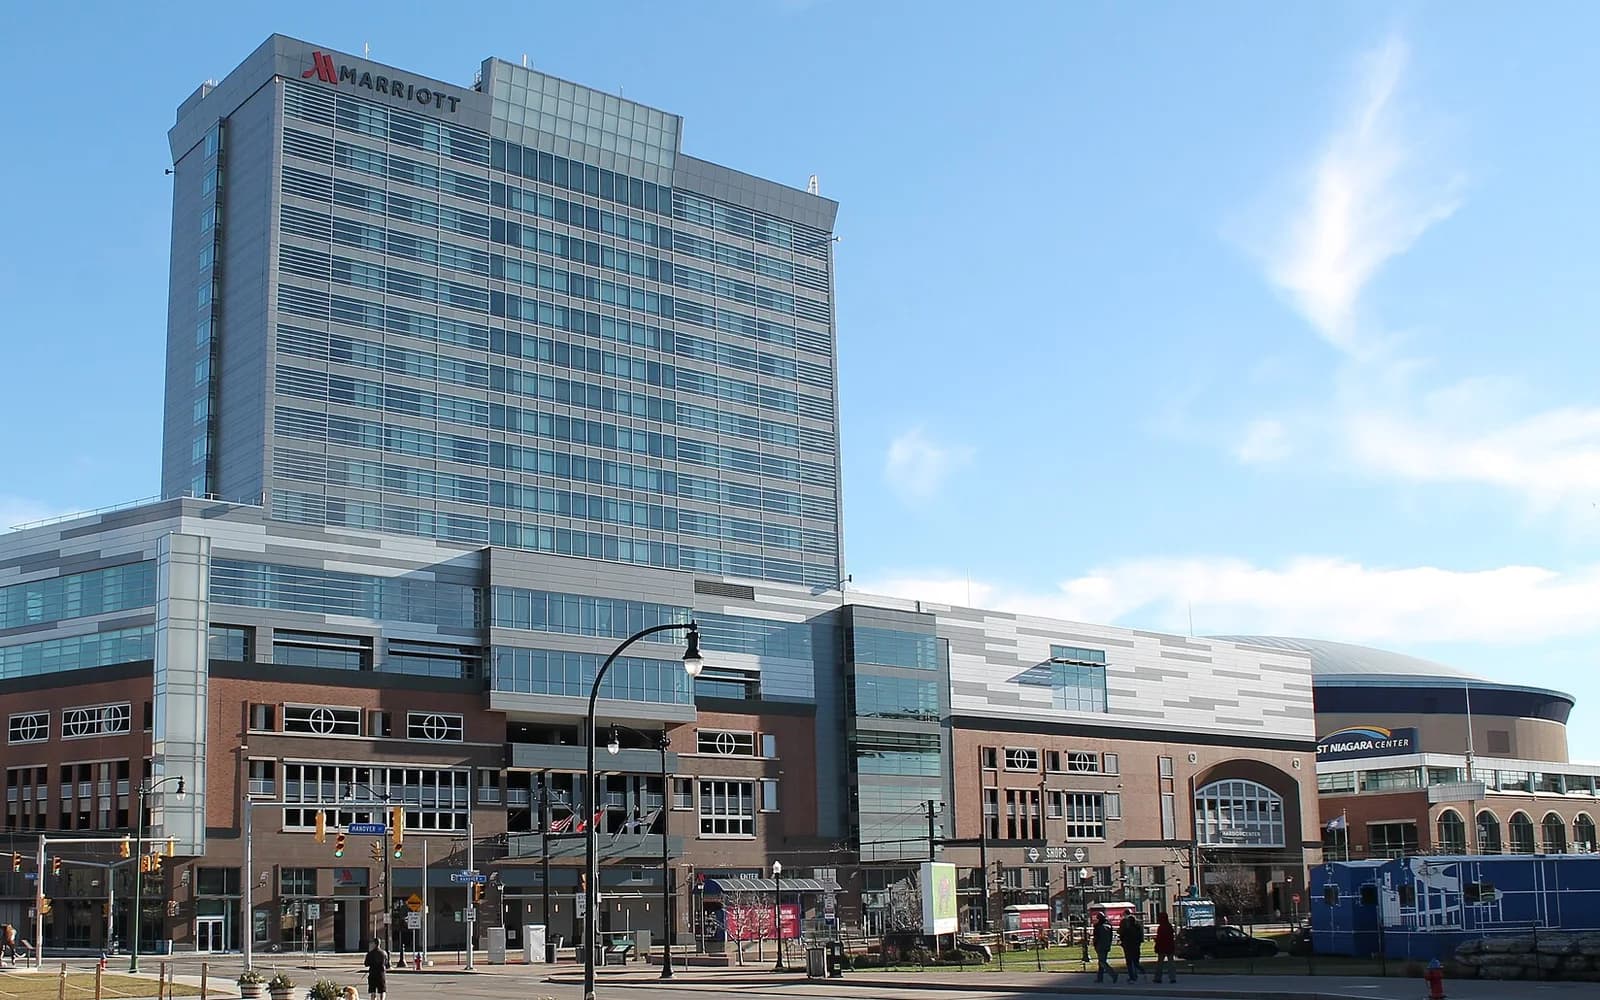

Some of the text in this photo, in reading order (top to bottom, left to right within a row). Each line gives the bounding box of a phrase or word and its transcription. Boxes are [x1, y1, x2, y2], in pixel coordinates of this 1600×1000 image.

[339, 65, 461, 113] MARRIOTT
[1330, 740, 1373, 753] NIAGARA
[1375, 739, 1409, 748] CENTER
[1046, 847, 1067, 858] SHOPS
